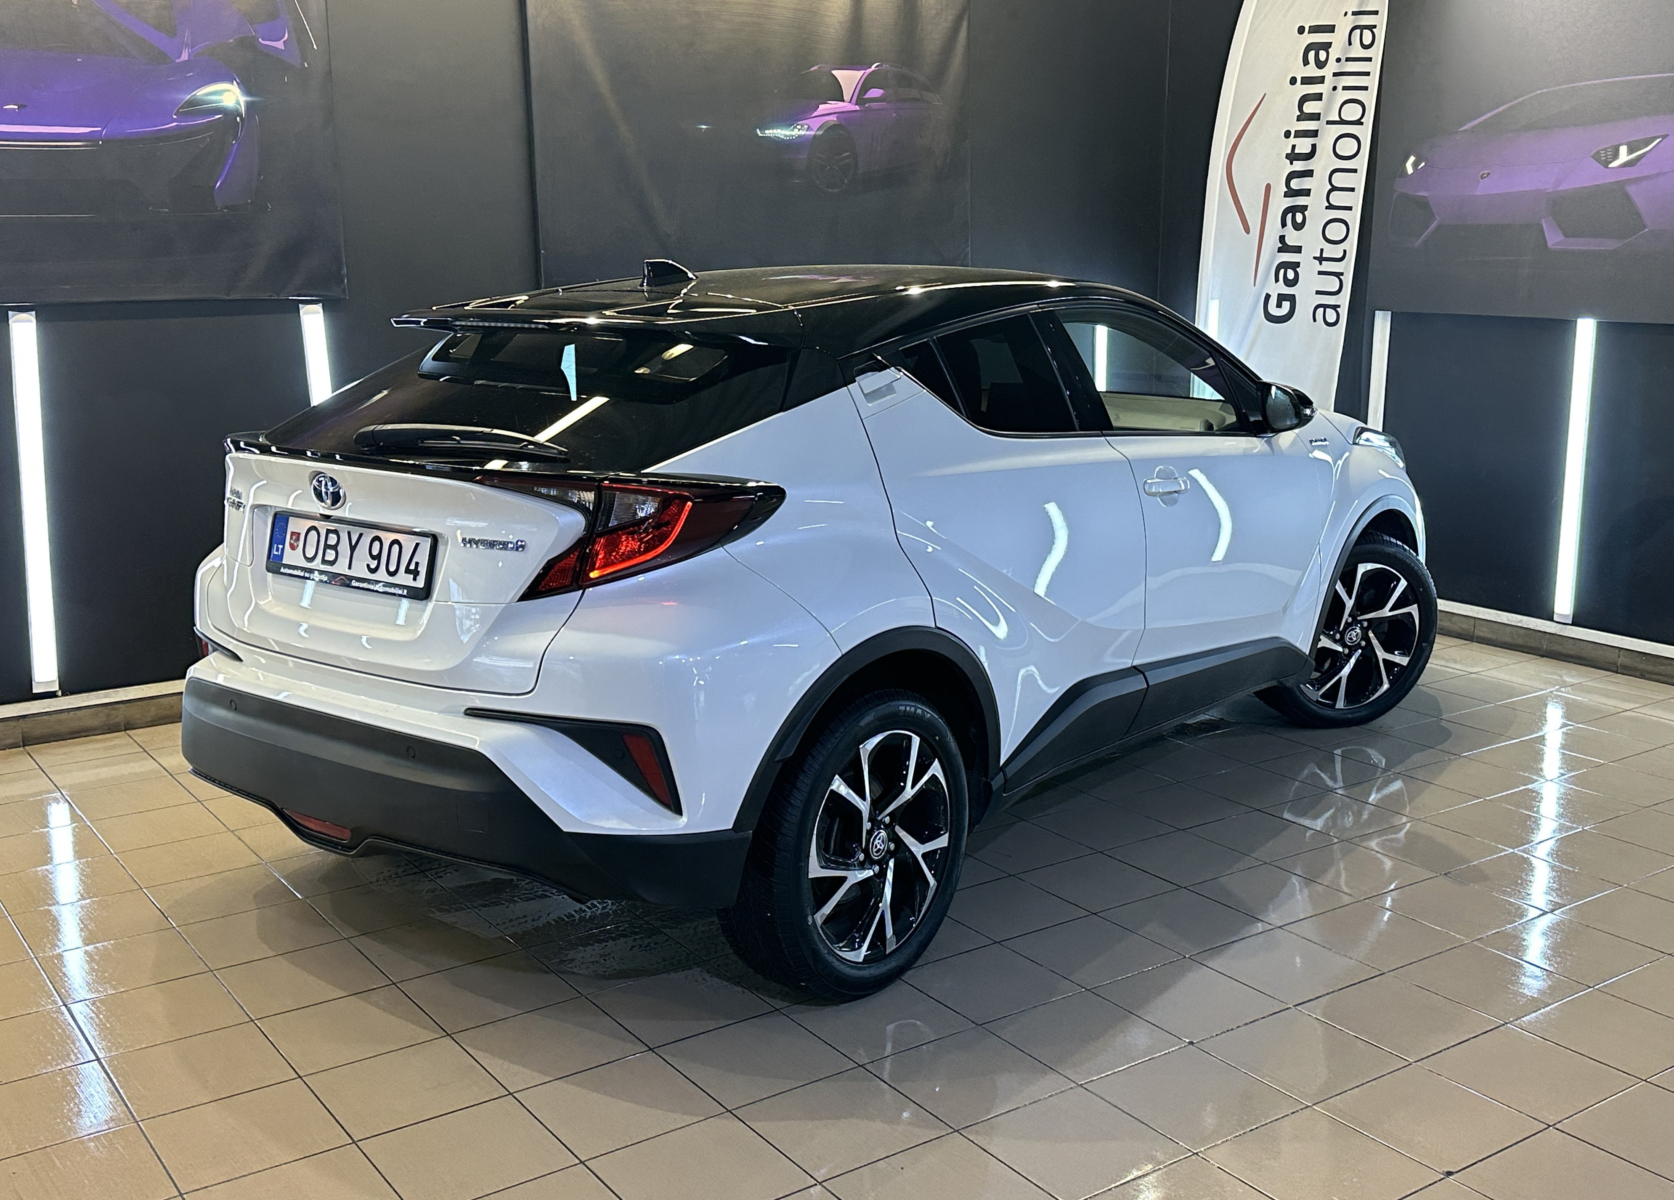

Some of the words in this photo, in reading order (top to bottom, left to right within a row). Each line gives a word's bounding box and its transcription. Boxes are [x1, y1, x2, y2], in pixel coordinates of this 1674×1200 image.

[1263, 24, 1335, 324] Garantiniai
[1312, 10, 1379, 327] automobiliai
[273, 544, 283, 556] LT
